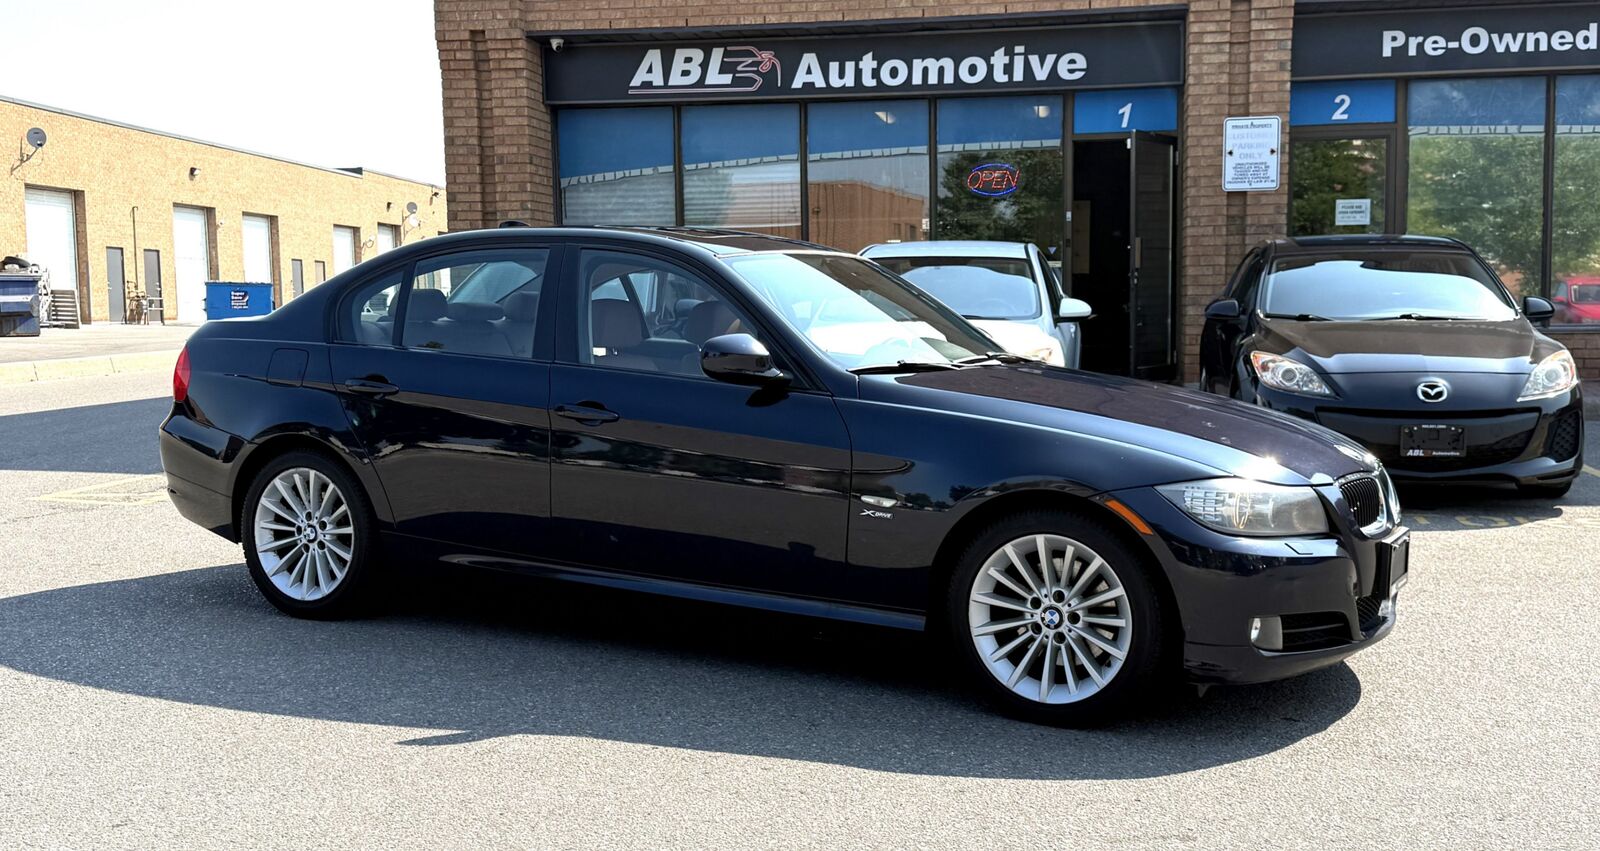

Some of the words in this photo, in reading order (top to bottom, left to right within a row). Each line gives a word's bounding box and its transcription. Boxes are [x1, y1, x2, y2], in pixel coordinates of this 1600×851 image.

[1382, 22, 1598, 58] Pre-Owned
[629, 47, 735, 88] ABL
[791, 45, 1088, 89] Automotive
[1118, 102, 1132, 128] 1
[1331, 94, 1351, 120] 2
[967, 168, 1020, 189] OPEN
